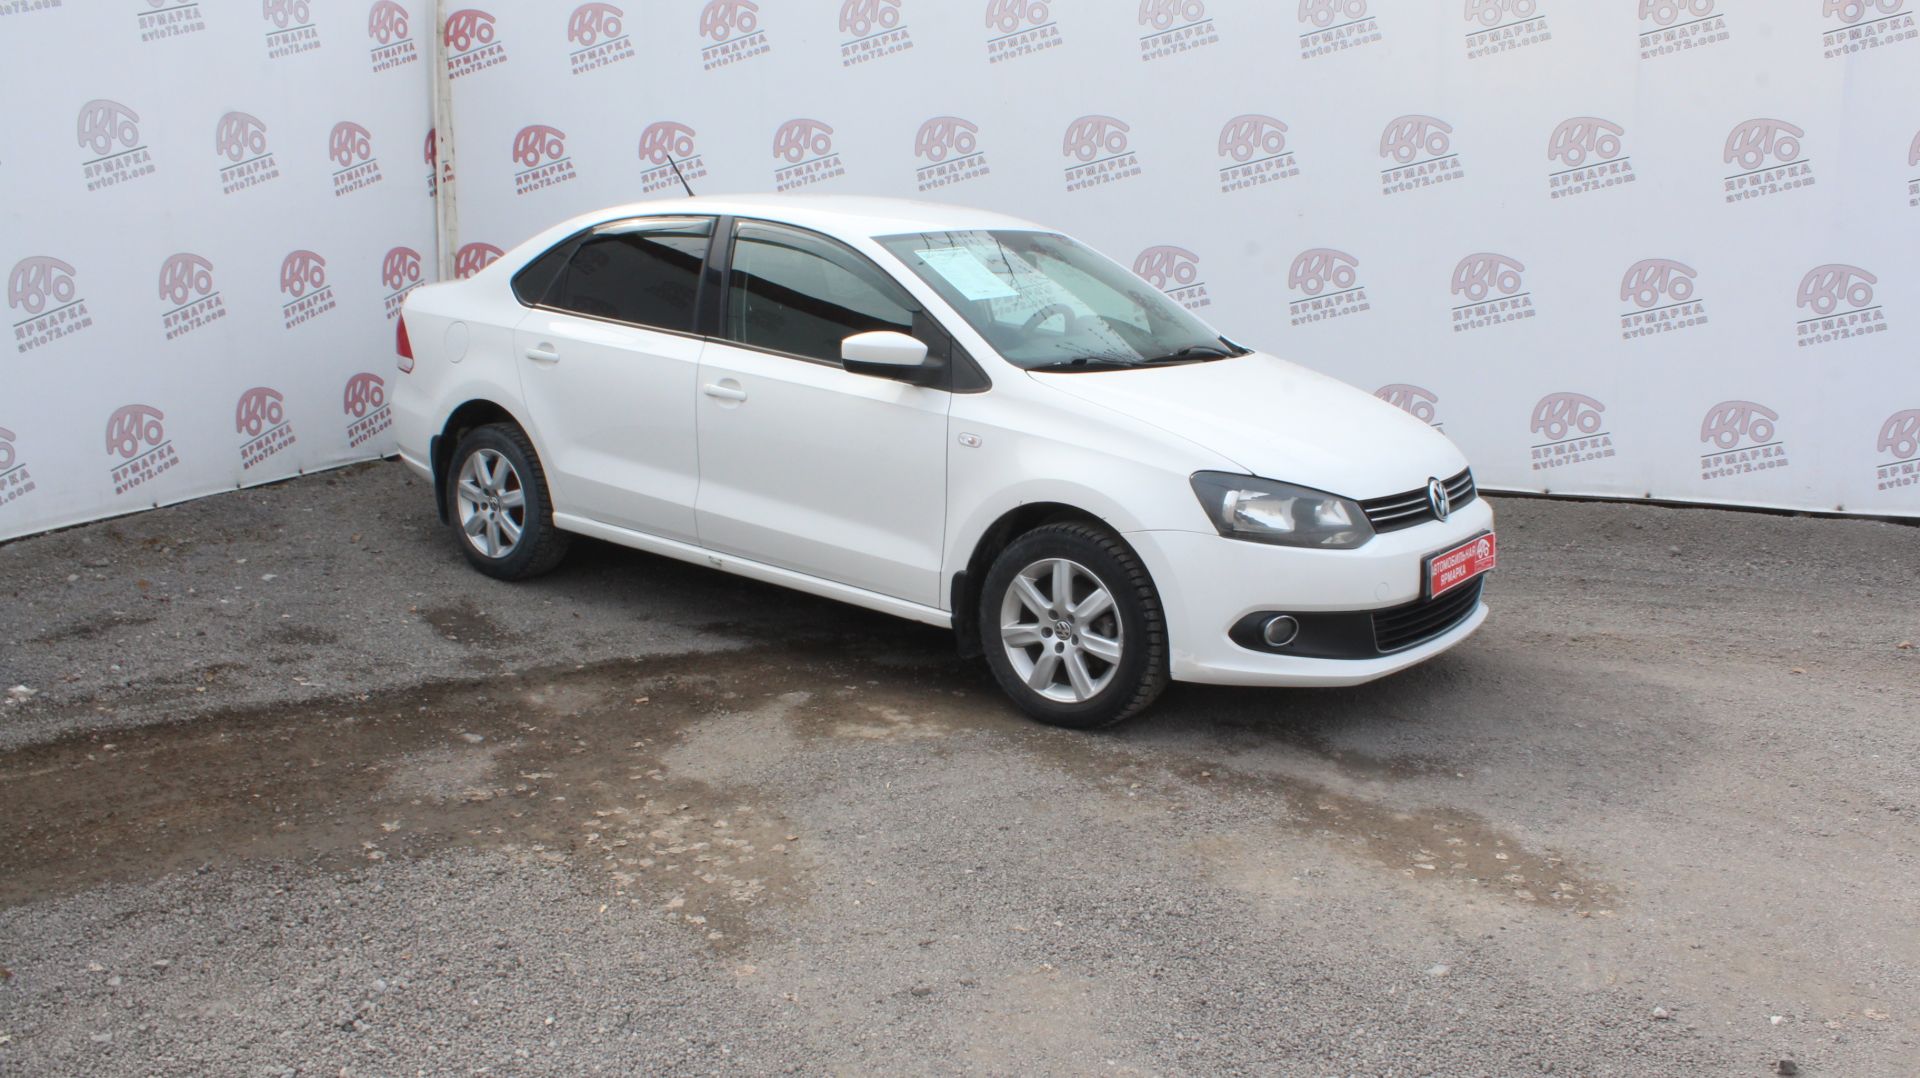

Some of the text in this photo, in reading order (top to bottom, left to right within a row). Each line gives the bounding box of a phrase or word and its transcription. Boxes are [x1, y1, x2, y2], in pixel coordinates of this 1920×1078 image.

[138, 8, 202, 29] ЯРМАРКА
[1823, 16, 1915, 47] ЯРМАРКА
[141, 22, 205, 42] avto72.com
[267, 28, 317, 48] ЯРМАРКА
[842, 30, 909, 57] ЯРМАРКА
[988, 26, 1059, 54] ЯРМАРКА
[1141, 23, 1215, 51] ЯРМАРКА
[1300, 21, 1378, 49] ЯРМАРКА
[1466, 20, 1548, 48] ЯРМАРКА
[1640, 19, 1726, 48] ЯРМАРКА
[1824, 29, 1918, 59] avto72.com
[269, 40, 320, 59] avto72.com
[371, 42, 415, 63] ЯРМАРКА
[447, 45, 504, 70] ЯРМАРКА
[571, 39, 631, 66] ЯРМАРКА
[702, 34, 767, 61] ЯРМАРКА
[704, 45, 770, 70] avto72.com
[843, 40, 913, 67] avto72.com
[989, 38, 1062, 63] avto72.com
[1142, 35, 1219, 61] avto72.com
[1302, 32, 1382, 59] avto72.com
[1468, 32, 1552, 59] avto72.com
[1641, 32, 1729, 59] avto72.com
[373, 53, 417, 72] avto72.com
[448, 55, 507, 80] avto72.com
[572, 49, 635, 75] avto72.com
[84, 151, 151, 179] ЯРМАРКА
[87, 165, 155, 191] avto72.com
[220, 157, 275, 183] ЯРМАРКА
[333, 163, 379, 187] ЯРМАРКА
[515, 161, 573, 186] ЯРМАРКА
[776, 157, 841, 183] ЯРМАРКА
[917, 156, 986, 182] ЯРМАРКА
[1065, 156, 1138, 182] ЯРМАРКА
[1220, 156, 1296, 182] ЯРМАРКА
[1382, 158, 1461, 184] ЯРМАРКА
[1549, 161, 1632, 188] ЯРМАРКА
[1725, 164, 1812, 192] ЯРМАРКА
[223, 170, 279, 194] avto72.com
[335, 173, 382, 197] avto72.com
[516, 170, 576, 195] avto72.com
[642, 169, 707, 193] avto72com
[777, 168, 845, 192] avto72.com
[919, 167, 990, 191] avto72.com
[1067, 167, 1141, 192] avto72.com
[1222, 168, 1300, 193] avto72.com
[1383, 170, 1464, 195] avto72.com
[1551, 173, 1636, 199] avto72.com
[1726, 177, 1815, 203] avto72.com
[163, 296, 222, 329] ЯРМАРКА
[284, 289, 333, 319] ЯРМАРКА
[285, 301, 336, 329] avto72.com
[1290, 291, 1367, 315] ЯРМАРКА
[1291, 303, 1370, 326] avto72.com
[1453, 297, 1532, 321] ЯРМАРКА
[1621, 303, 1704, 328] ЯРМАРКА
[14, 304, 87, 341] ЯРМАРКА
[166, 308, 226, 340] avto72.com
[1454, 309, 1536, 332] avto72.com
[1622, 316, 1709, 339] avto72.com
[1797, 310, 1884, 336] ЯРМАРКА
[16, 317, 92, 353] avto72.com
[1798, 323, 1888, 347] avto72.com
[348, 407, 391, 438] ЯРМАРКА
[241, 425, 292, 460] ЯРМАРКА
[243, 436, 296, 470] avto72.com
[1532, 437, 1612, 459] ЯРМАРКА
[112, 445, 175, 484] ЯРМАРКА
[1533, 449, 1616, 470] avto72.com
[1701, 446, 1786, 469] ЯРМАРКА
[1702, 458, 1789, 480] avto72.com
[115, 456, 179, 495] avto72.com
